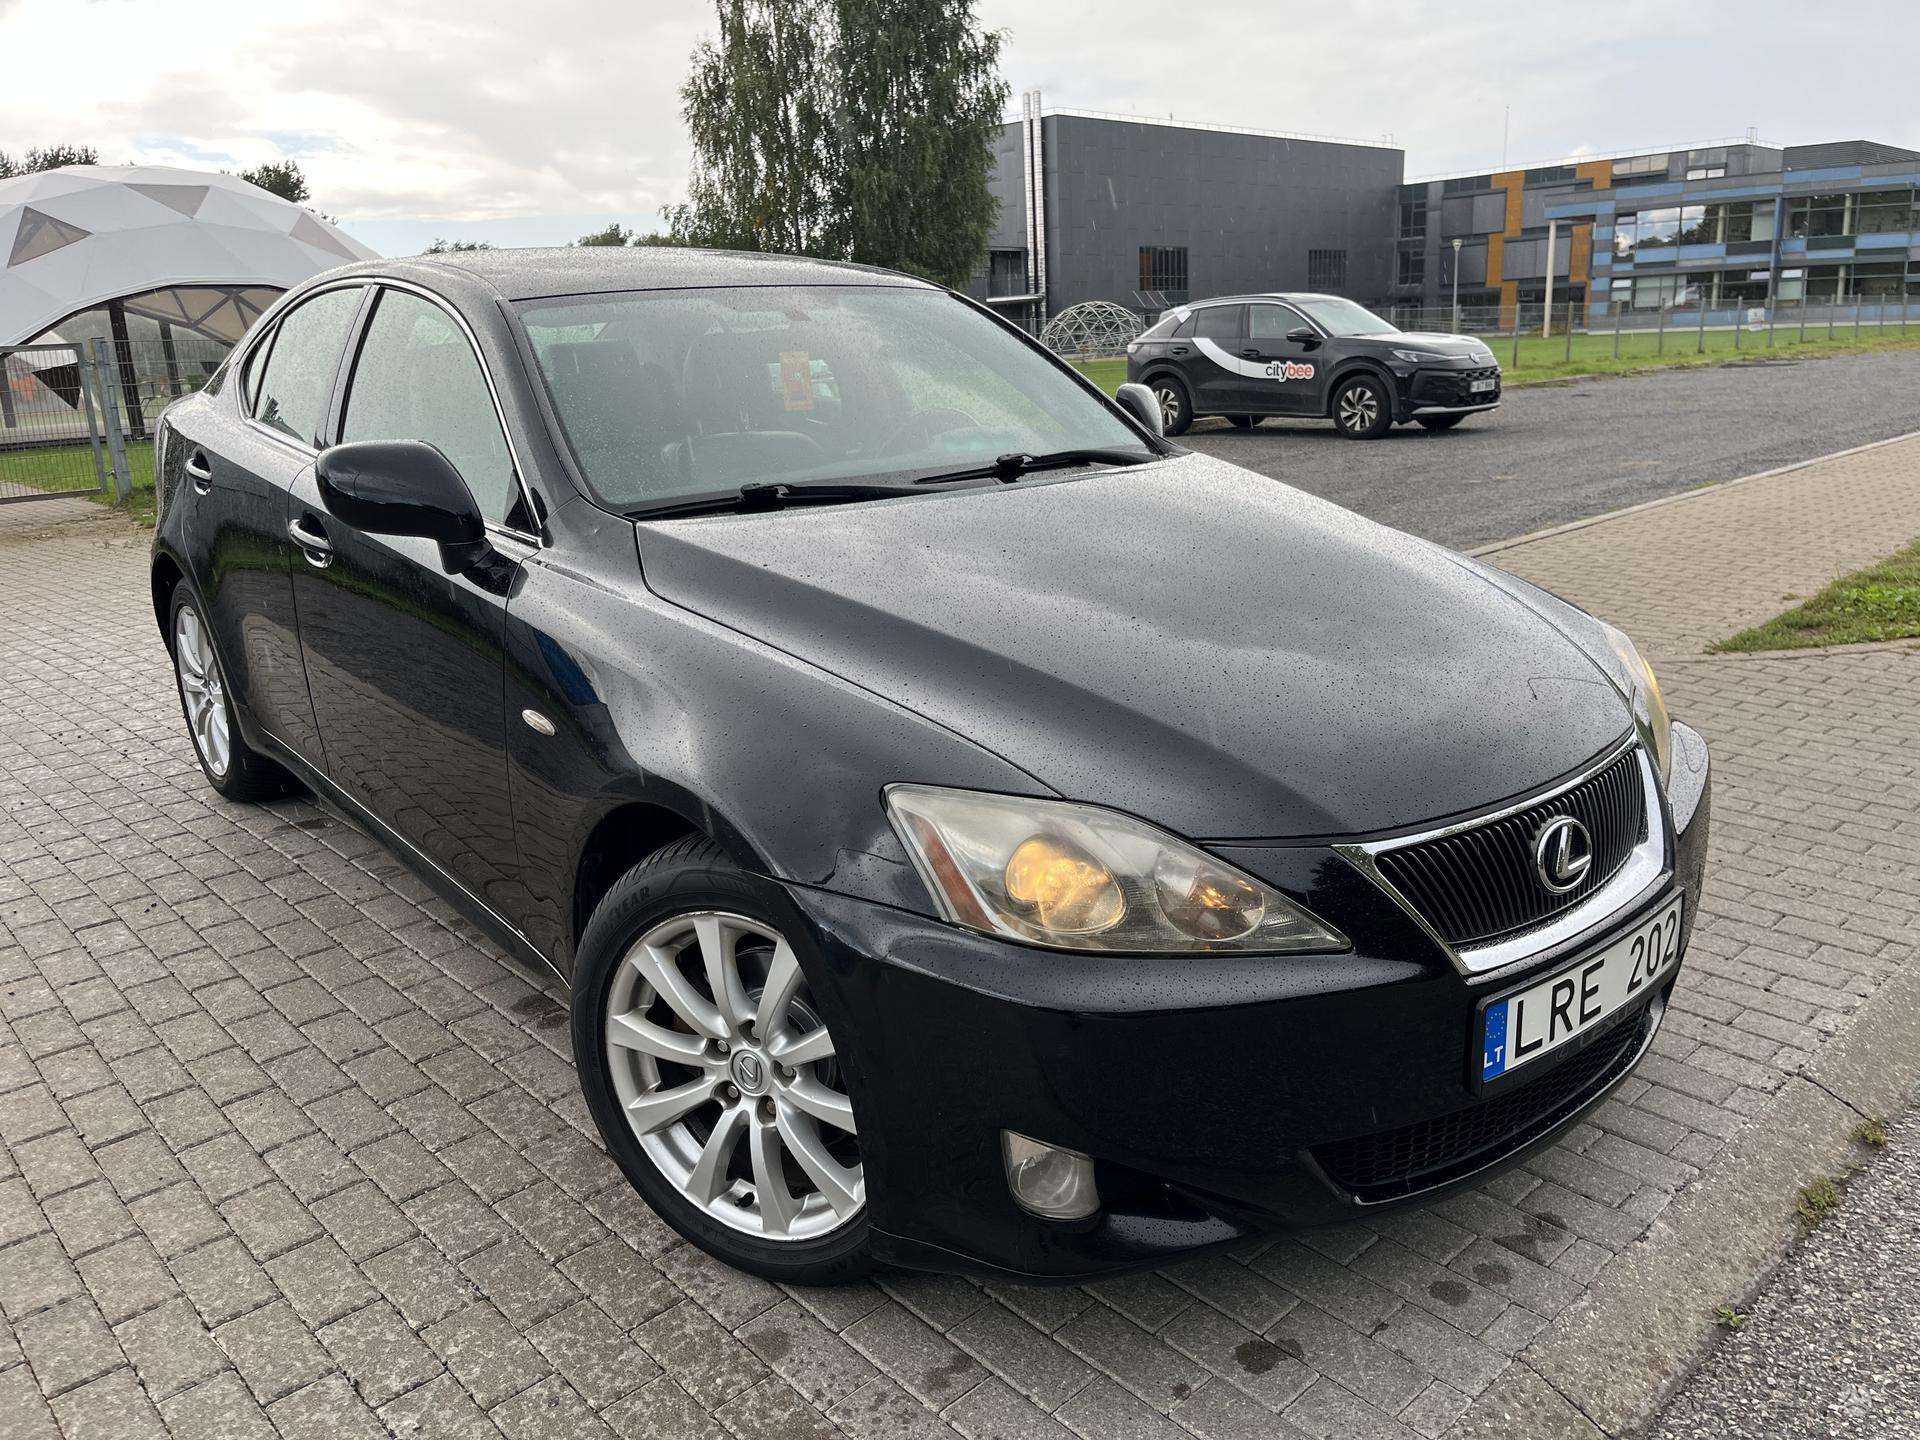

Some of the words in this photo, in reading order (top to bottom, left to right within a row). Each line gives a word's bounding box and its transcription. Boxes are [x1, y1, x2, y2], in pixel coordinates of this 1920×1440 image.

[1265, 363, 1313, 380] citybee
[1514, 957, 1606, 1060] LRE
[1626, 909, 1677, 995] 202
[1483, 1044, 1505, 1069] LT
